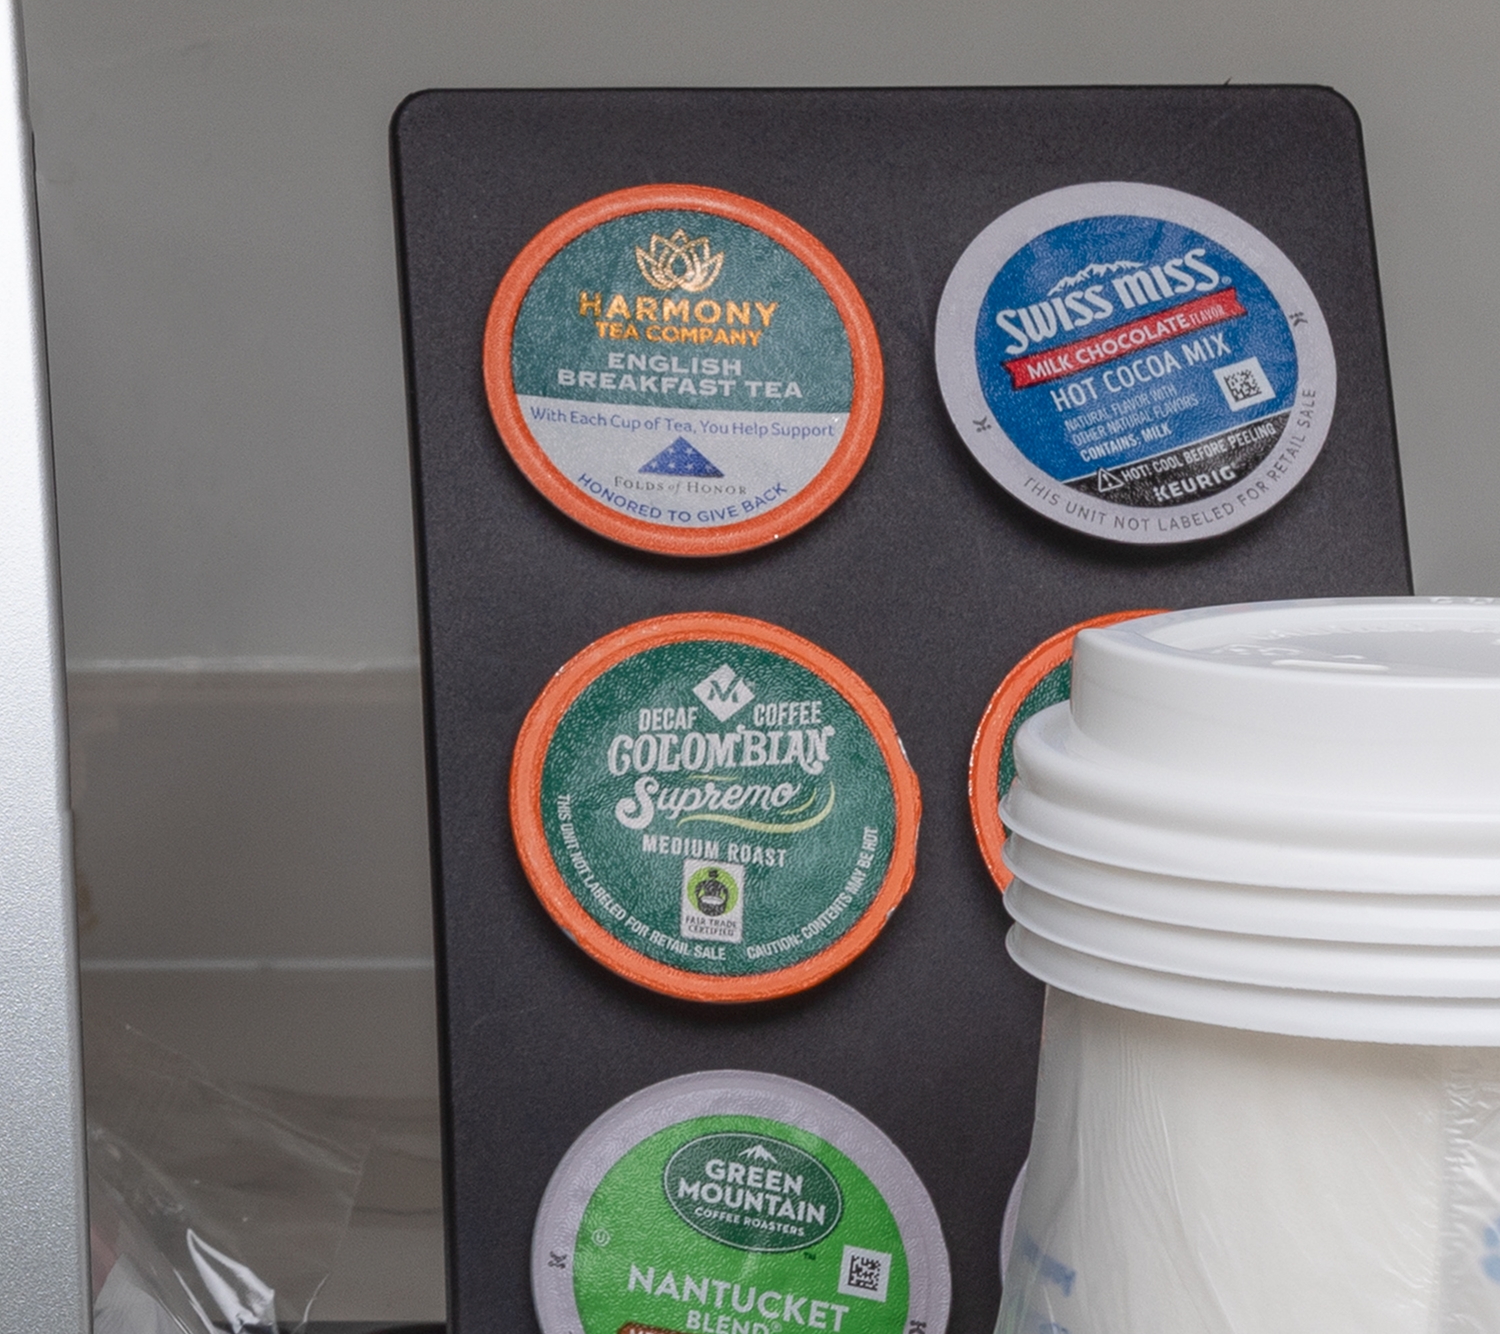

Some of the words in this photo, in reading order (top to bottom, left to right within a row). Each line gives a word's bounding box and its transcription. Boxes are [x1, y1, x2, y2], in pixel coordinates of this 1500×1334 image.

[577, 289, 779, 328] HARMONY
[995, 284, 1115, 356] SWISS
[596, 321, 639, 341] TEA
[645, 325, 762, 347] COMPANY
[1025, 352, 1077, 381] MILK
[1075, 313, 1188, 365] CHOCOLATE
[1188, 304, 1225, 327] FLAVOR
[607, 352, 742, 377] ENGLISH
[1050, 377, 1098, 413] HOT
[1101, 350, 1183, 395] COCOA
[1181, 332, 1232, 366] MIX
[557, 368, 736, 398] BREAKFAST
[745, 381, 803, 399] TEA
[530, 406, 568, 424] With
[570, 411, 608, 428] Each
[610, 415, 642, 433] Cup
[644, 416, 662, 431] of
[664, 418, 698, 435] Tea,
[699, 420, 729, 435] You
[731, 422, 769, 440] Help
[771, 422, 836, 441] Support
[1063, 404, 1110, 433] NATURAL
[1110, 395, 1150, 419] FLAVOR
[1150, 383, 1176, 405] WITH
[1070, 424, 1107, 447] OTHER
[1106, 408, 1152, 436] NATURAL
[1151, 393, 1200, 421] FLAVORS
[1023, 475, 1061, 507] THIS
[1065, 495, 1107, 525] UNIT
[1113, 515, 1150, 532] NOT
[1158, 500, 1235, 533] LABELED
[1236, 480, 1269, 508] FOR
[1271, 433, 1307, 484] RETAIL
[1300, 388, 1317, 429] SALE
[1079, 433, 1142, 463] CONTAINS:
[1141, 423, 1173, 445] MILK
[1121, 464, 1152, 483] HOT!
[1151, 455, 1184, 475] COOL
[1183, 439, 1228, 467] BEFORE
[1228, 422, 1277, 451] PEELING
[577, 472, 662, 521] HONORED
[667, 509, 691, 523] TO
[696, 505, 740, 524] GIVE
[741, 482, 788, 513] BACK
[1152, 465, 1237, 503] KEURIG
[638, 706, 699, 732] DECAF
[754, 700, 823, 727] COFFEE
[607, 724, 836, 777] COLOMBIAN
[556, 793, 572, 822] THIS
[615, 775, 801, 830] Supremo
[559, 822, 580, 851] UNIT
[642, 833, 720, 860] MEDIUM
[727, 842, 787, 868] ROAST
[861, 825, 879, 853] HOT
[569, 849, 592, 877] NOT
[856, 850, 875, 870] BE
[583, 874, 627, 921] LABELED
[843, 867, 868, 896] MAY
[624, 915, 651, 938] FOR
[709, 918, 738, 929] TRADE
[800, 891, 853, 940] CONTENTS
[649, 930, 692, 957] RETAIL
[693, 945, 727, 961] SALE
[746, 932, 804, 960] CAUTION:
[704, 1158, 804, 1197] GREEN
[677, 1177, 827, 1227] MOUNTAIN
[694, 1206, 741, 1226] COFFEE
[742, 1216, 806, 1238] ROASTERS
[626, 1264, 850, 1333] NANTUCKET
